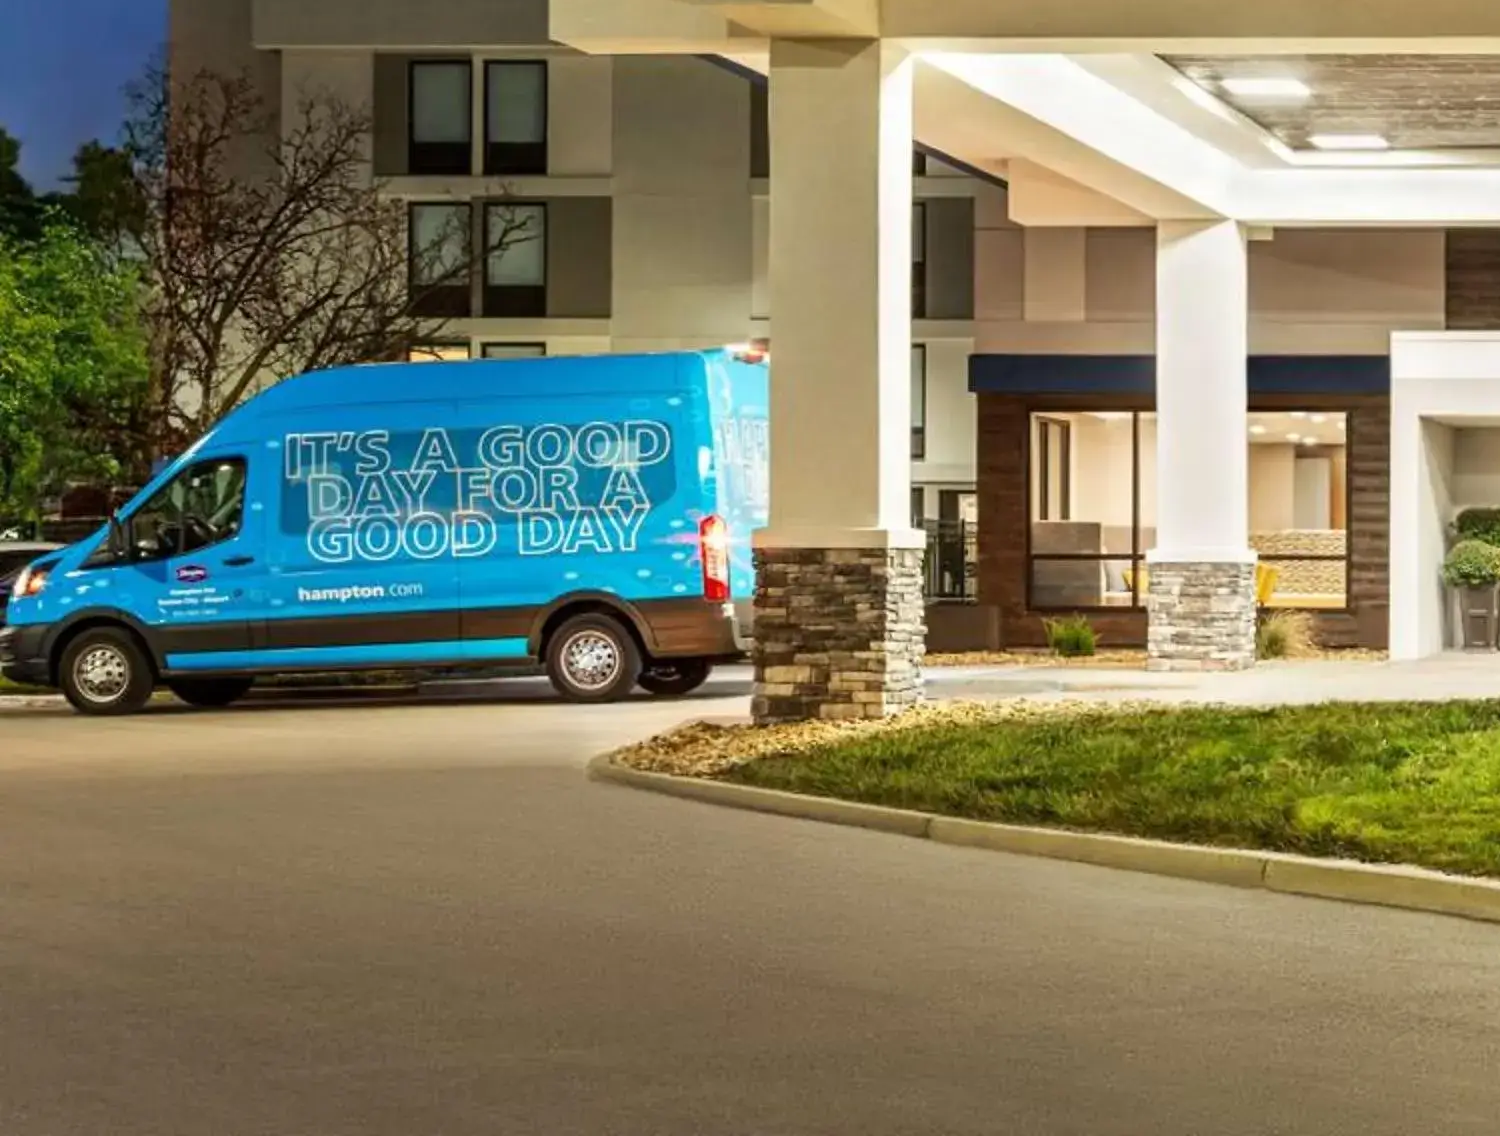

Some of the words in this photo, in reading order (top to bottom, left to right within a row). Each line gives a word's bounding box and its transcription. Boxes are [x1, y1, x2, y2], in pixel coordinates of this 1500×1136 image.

[284, 431, 393, 479] IT'S
[411, 427, 459, 473] A
[478, 419, 671, 469] GOOD
[307, 469, 437, 519] DAY
[457, 465, 581, 514] FOR
[599, 466, 651, 510] A
[306, 510, 498, 563] GOOD
[517, 505, 651, 555] DAY
